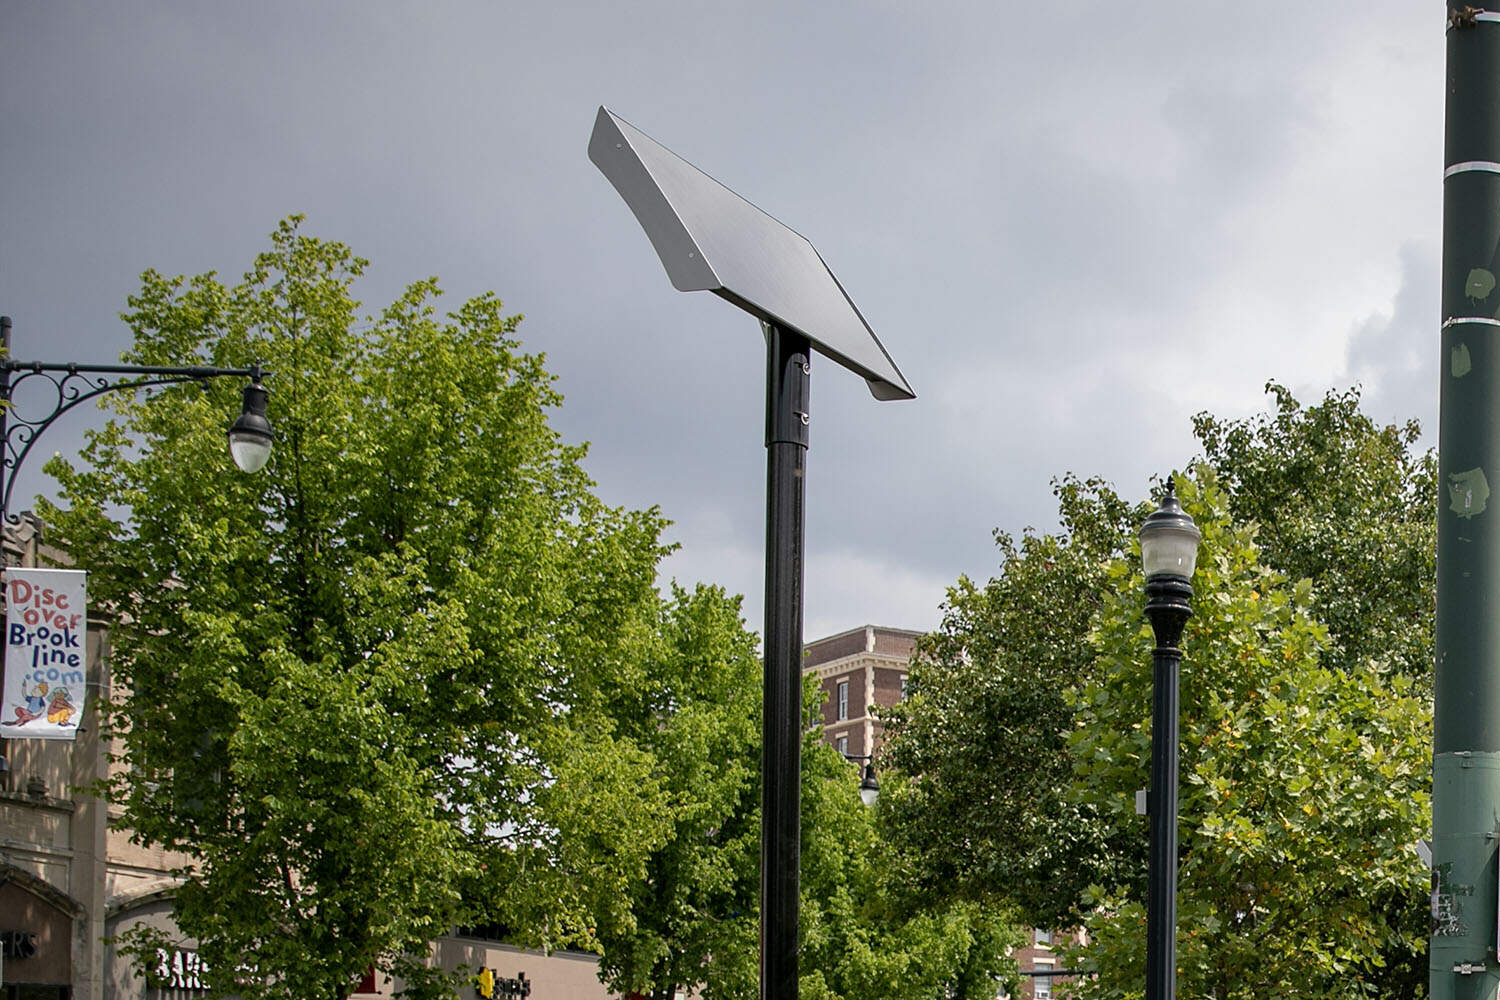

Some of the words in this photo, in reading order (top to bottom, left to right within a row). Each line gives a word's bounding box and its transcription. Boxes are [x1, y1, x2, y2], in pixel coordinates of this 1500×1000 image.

[9, 623, 79, 648] Brook
[32, 644, 80, 668] line
[25, 668, 83, 685] .com
